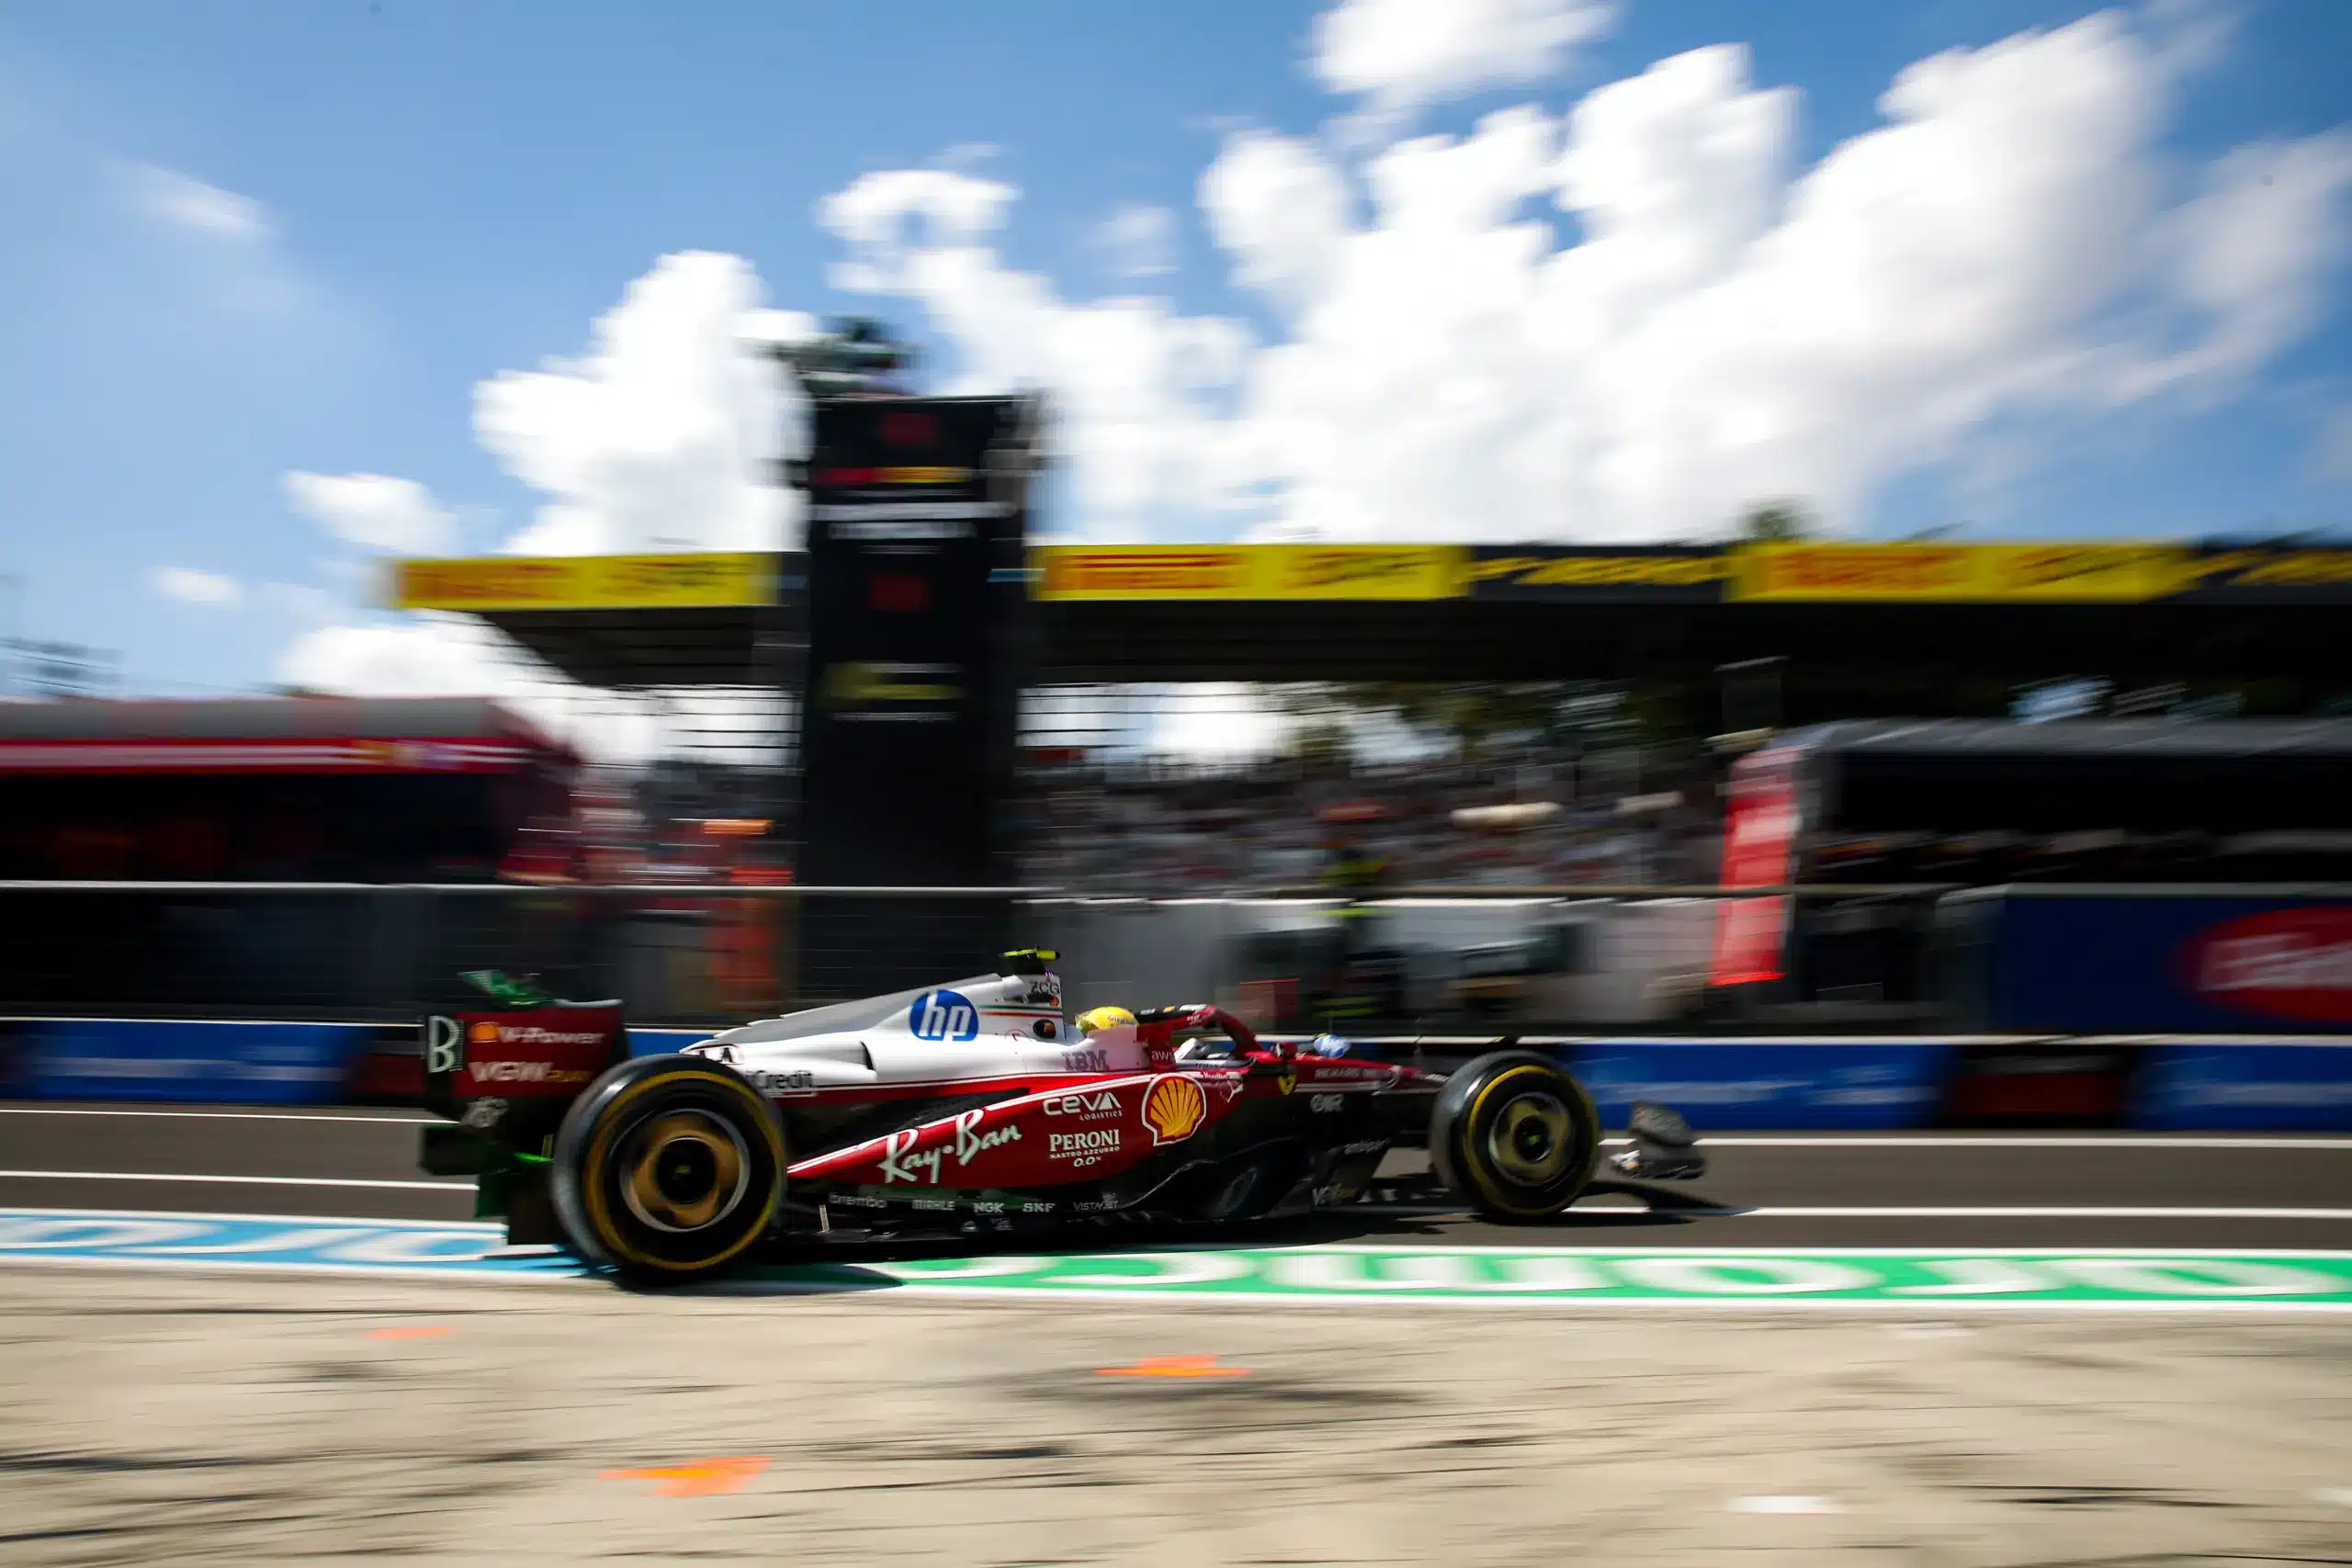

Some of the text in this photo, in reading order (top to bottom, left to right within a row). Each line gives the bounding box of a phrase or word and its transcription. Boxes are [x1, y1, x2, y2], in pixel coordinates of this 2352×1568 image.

[916, 989, 973, 1041] hp
[1061, 1049, 1110, 1071] IBM
[1079, 1110, 1123, 1121] LOGISTICS
[1048, 1129, 1121, 1152] PERONI
[1049, 1145, 1120, 1159] NASTRO AZZURRO
[973, 1201, 1005, 1213] NGK
[1022, 1202, 1056, 1213] SKF
